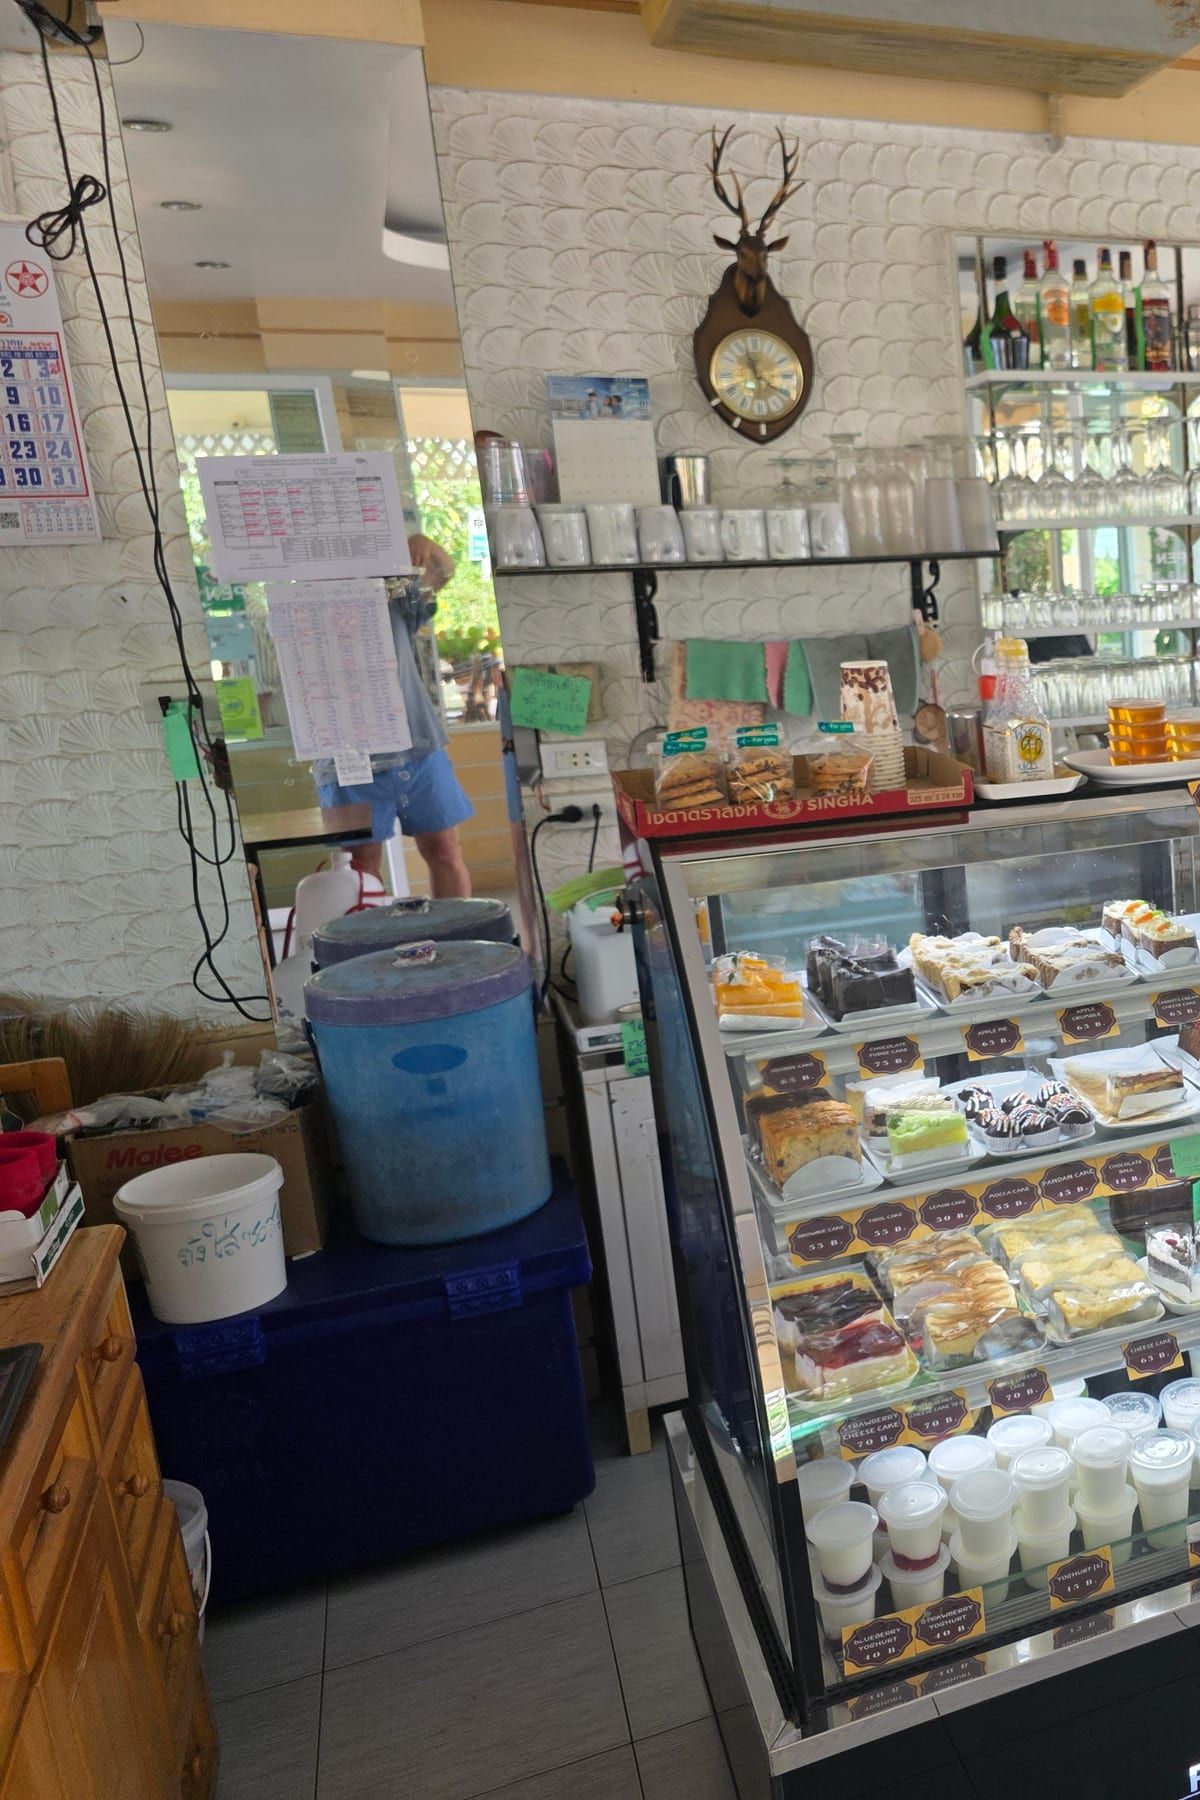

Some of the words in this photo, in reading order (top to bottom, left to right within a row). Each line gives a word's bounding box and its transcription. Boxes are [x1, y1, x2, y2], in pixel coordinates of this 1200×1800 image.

[1, 359, 15, 378] 2
[6, 386, 20, 405] 9
[36, 386, 62, 405] 10
[6, 413, 31, 432] 16
[41, 413, 65, 432] 17
[9, 441, 37, 459] 23
[45, 441, 72, 459] 24
[14, 468, 42, 486] 30
[51, 467, 77, 486] 31
[807, 794, 874, 812] SINGHA
[105, 1143, 203, 1169] Malee
[1108, 1160, 1142, 1169] CHOCOLATE
[1041, 1174, 1073, 1187] PANDAN
[1074, 1168, 1095, 1178] CAKE
[1012, 1186, 1030, 1194] CAKE
[1130, 1343, 1155, 1354] CHEESE
[1155, 1338, 1171, 1346] CAKE
[841, 1412, 899, 1432] STRAWBERRY
[842, 1428, 876, 1441] CHEESE
[877, 1422, 899, 1432] CAKE
[1057, 1566, 1092, 1582] YOGHURT
[921, 1604, 974, 1625] STRAWBERRY
[928, 1614, 967, 1630] YOGHURT
[853, 1628, 901, 1645] BLUEBERRY
[858, 1636, 898, 1651] YOGHURT
